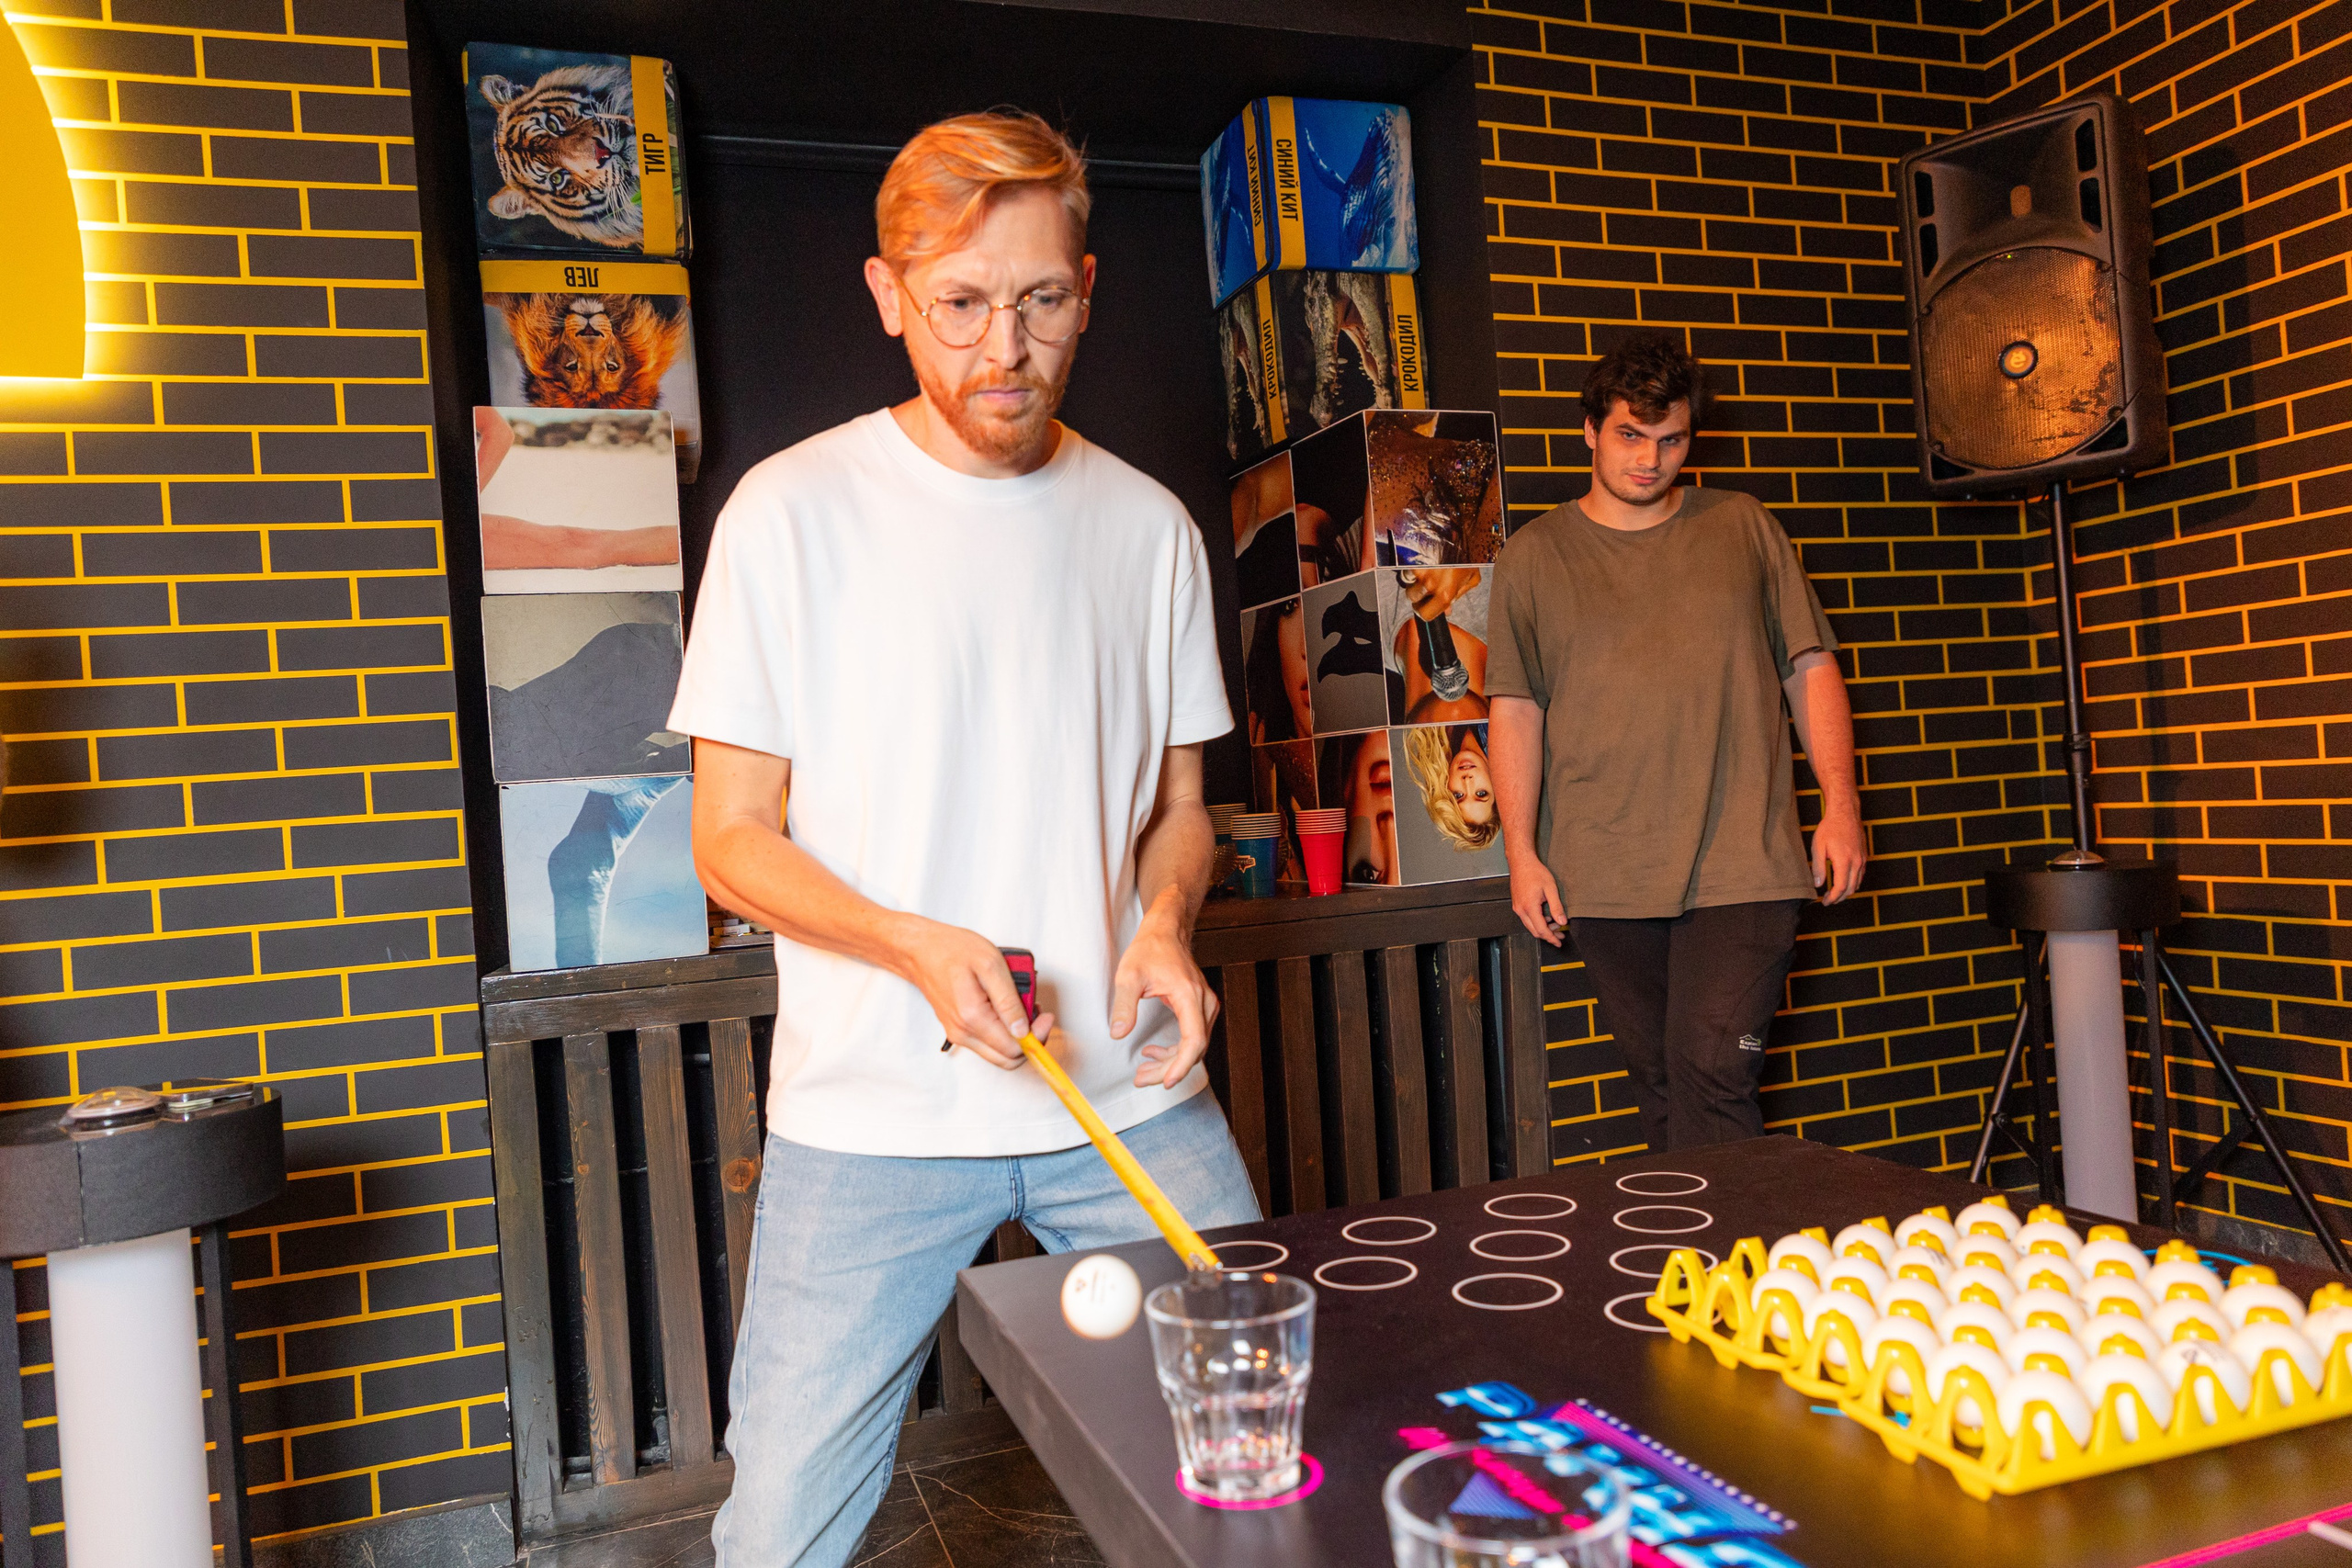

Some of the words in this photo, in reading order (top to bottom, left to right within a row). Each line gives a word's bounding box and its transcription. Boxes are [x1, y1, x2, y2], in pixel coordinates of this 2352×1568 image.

[642, 133, 665, 175] ТИГР
[1247, 143, 1257, 174] КИТ
[1276, 139, 1299, 190] СИНИЙ
[1250, 175, 1262, 227] СИНИЙ
[1281, 192, 1298, 221] КИТ
[564, 266, 599, 288] ЛЕВ
[1262, 319, 1279, 400] КРОКОДИЛ
[1397, 314, 1419, 392] КРОКОДИЛ
